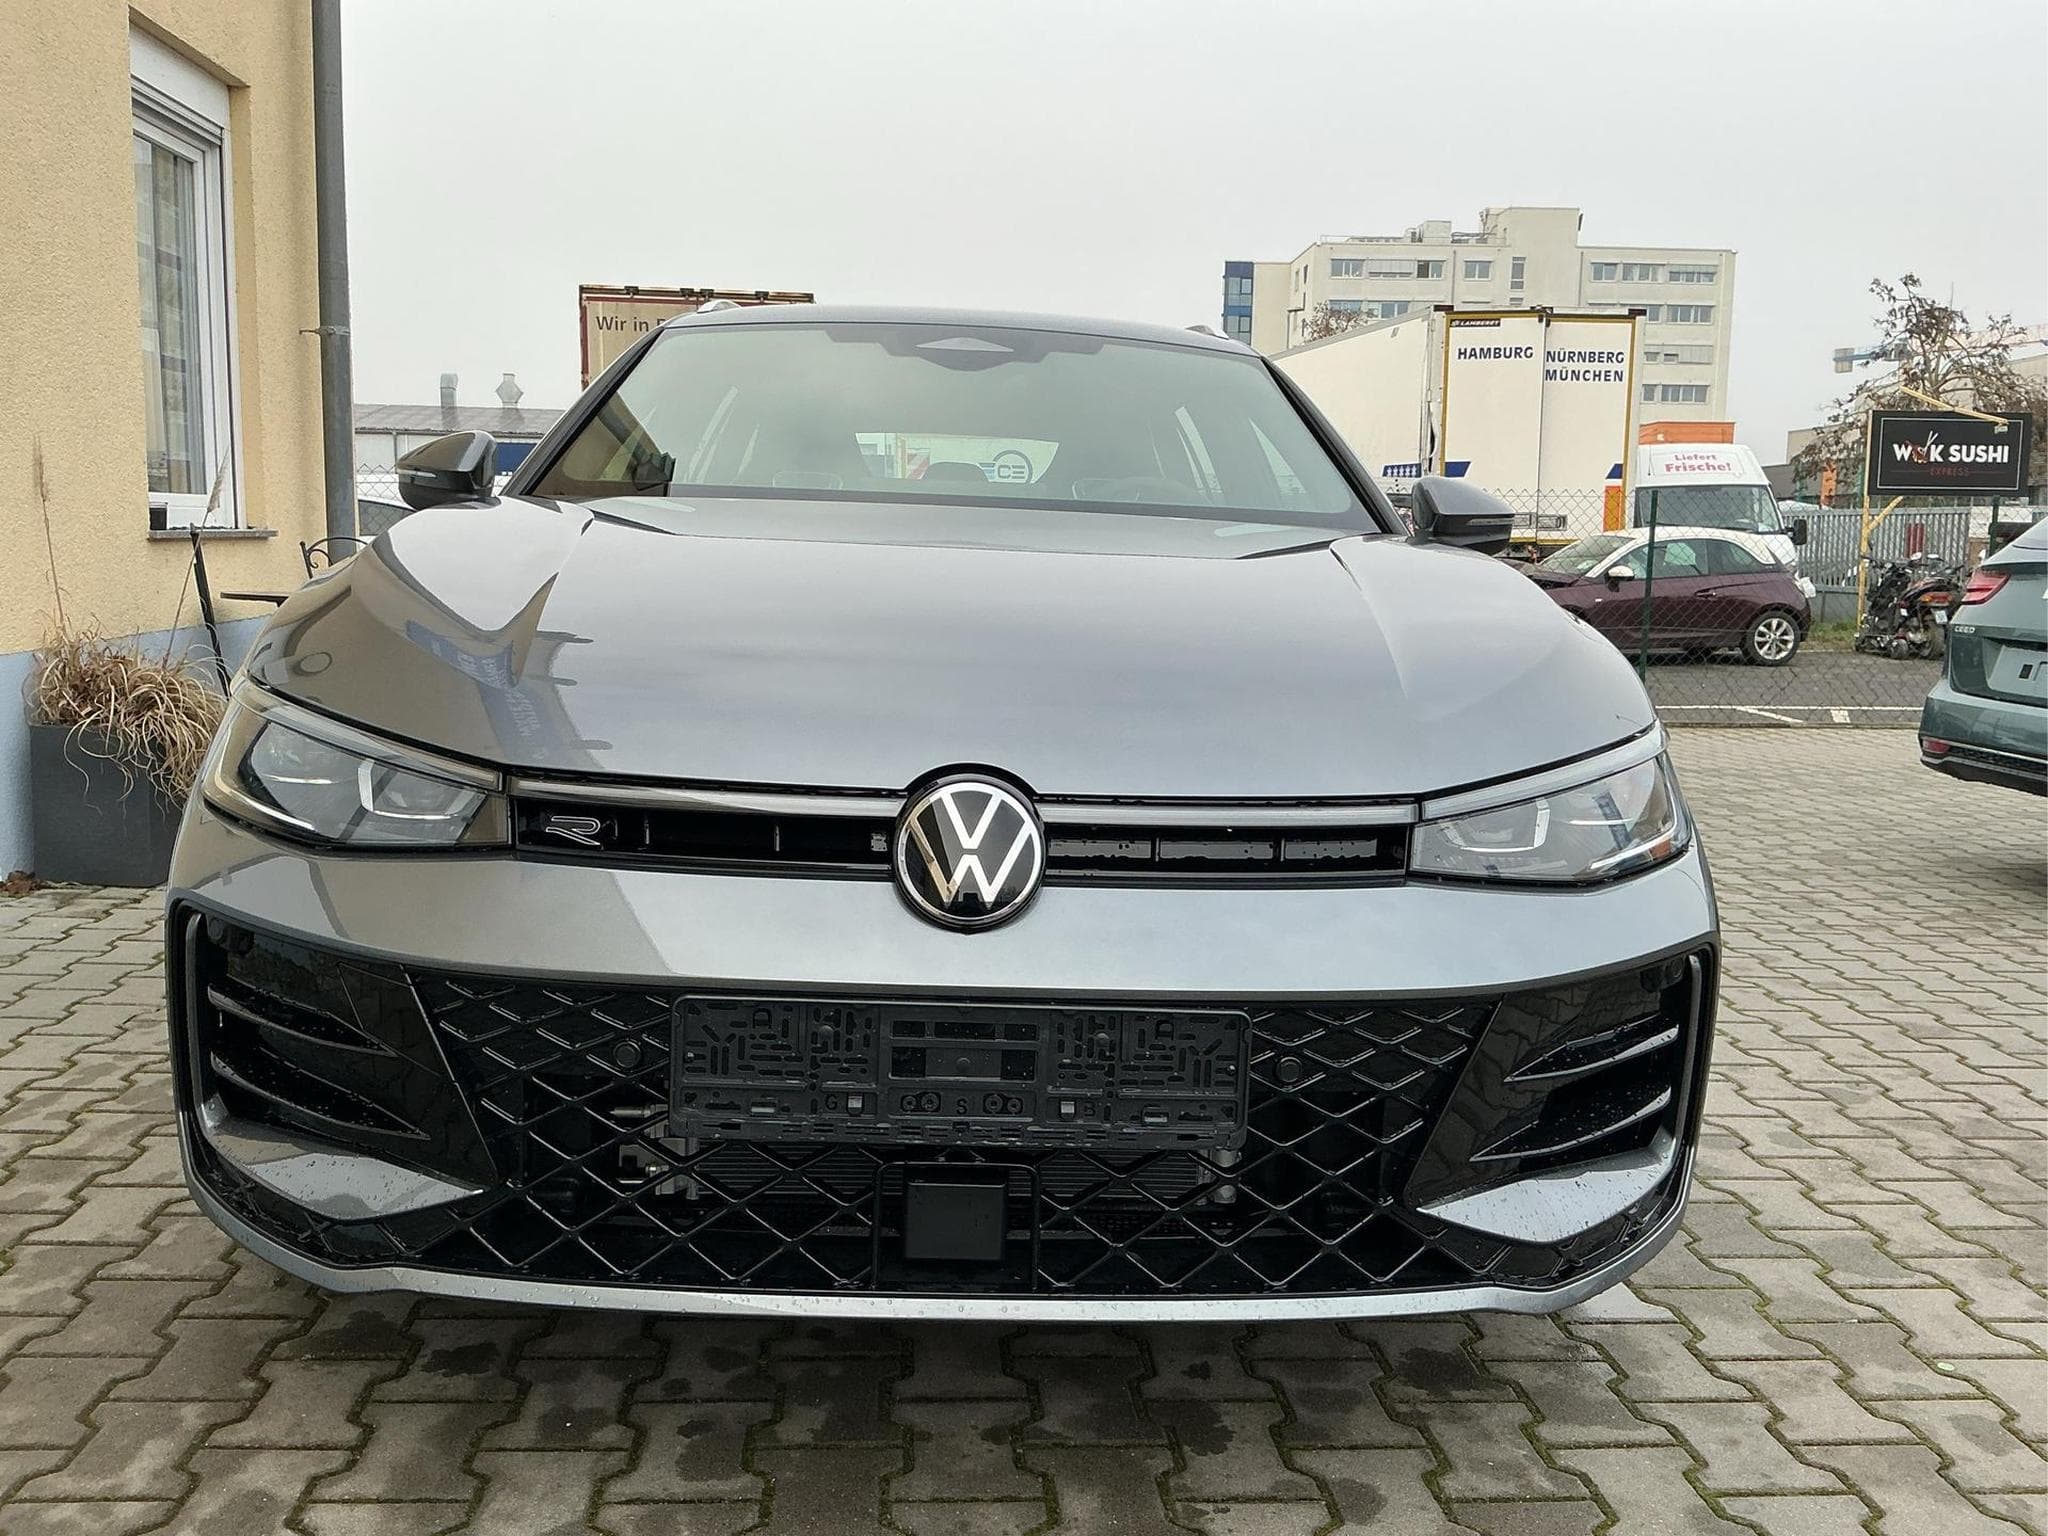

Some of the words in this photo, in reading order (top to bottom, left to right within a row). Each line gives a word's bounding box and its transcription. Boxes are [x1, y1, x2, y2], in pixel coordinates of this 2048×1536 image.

[596, 315, 627, 331] Wir
[633, 316, 649, 332] in
[1457, 346, 1534, 360] HAMBURG
[1545, 348, 1625, 364] NÜRNBERG
[1545, 367, 1624, 382] MÜNCHEN
[1948, 444, 2010, 463] SUSHI
[1664, 462, 1732, 472] Frische!
[1929, 467, 1970, 477] EXPRESS
